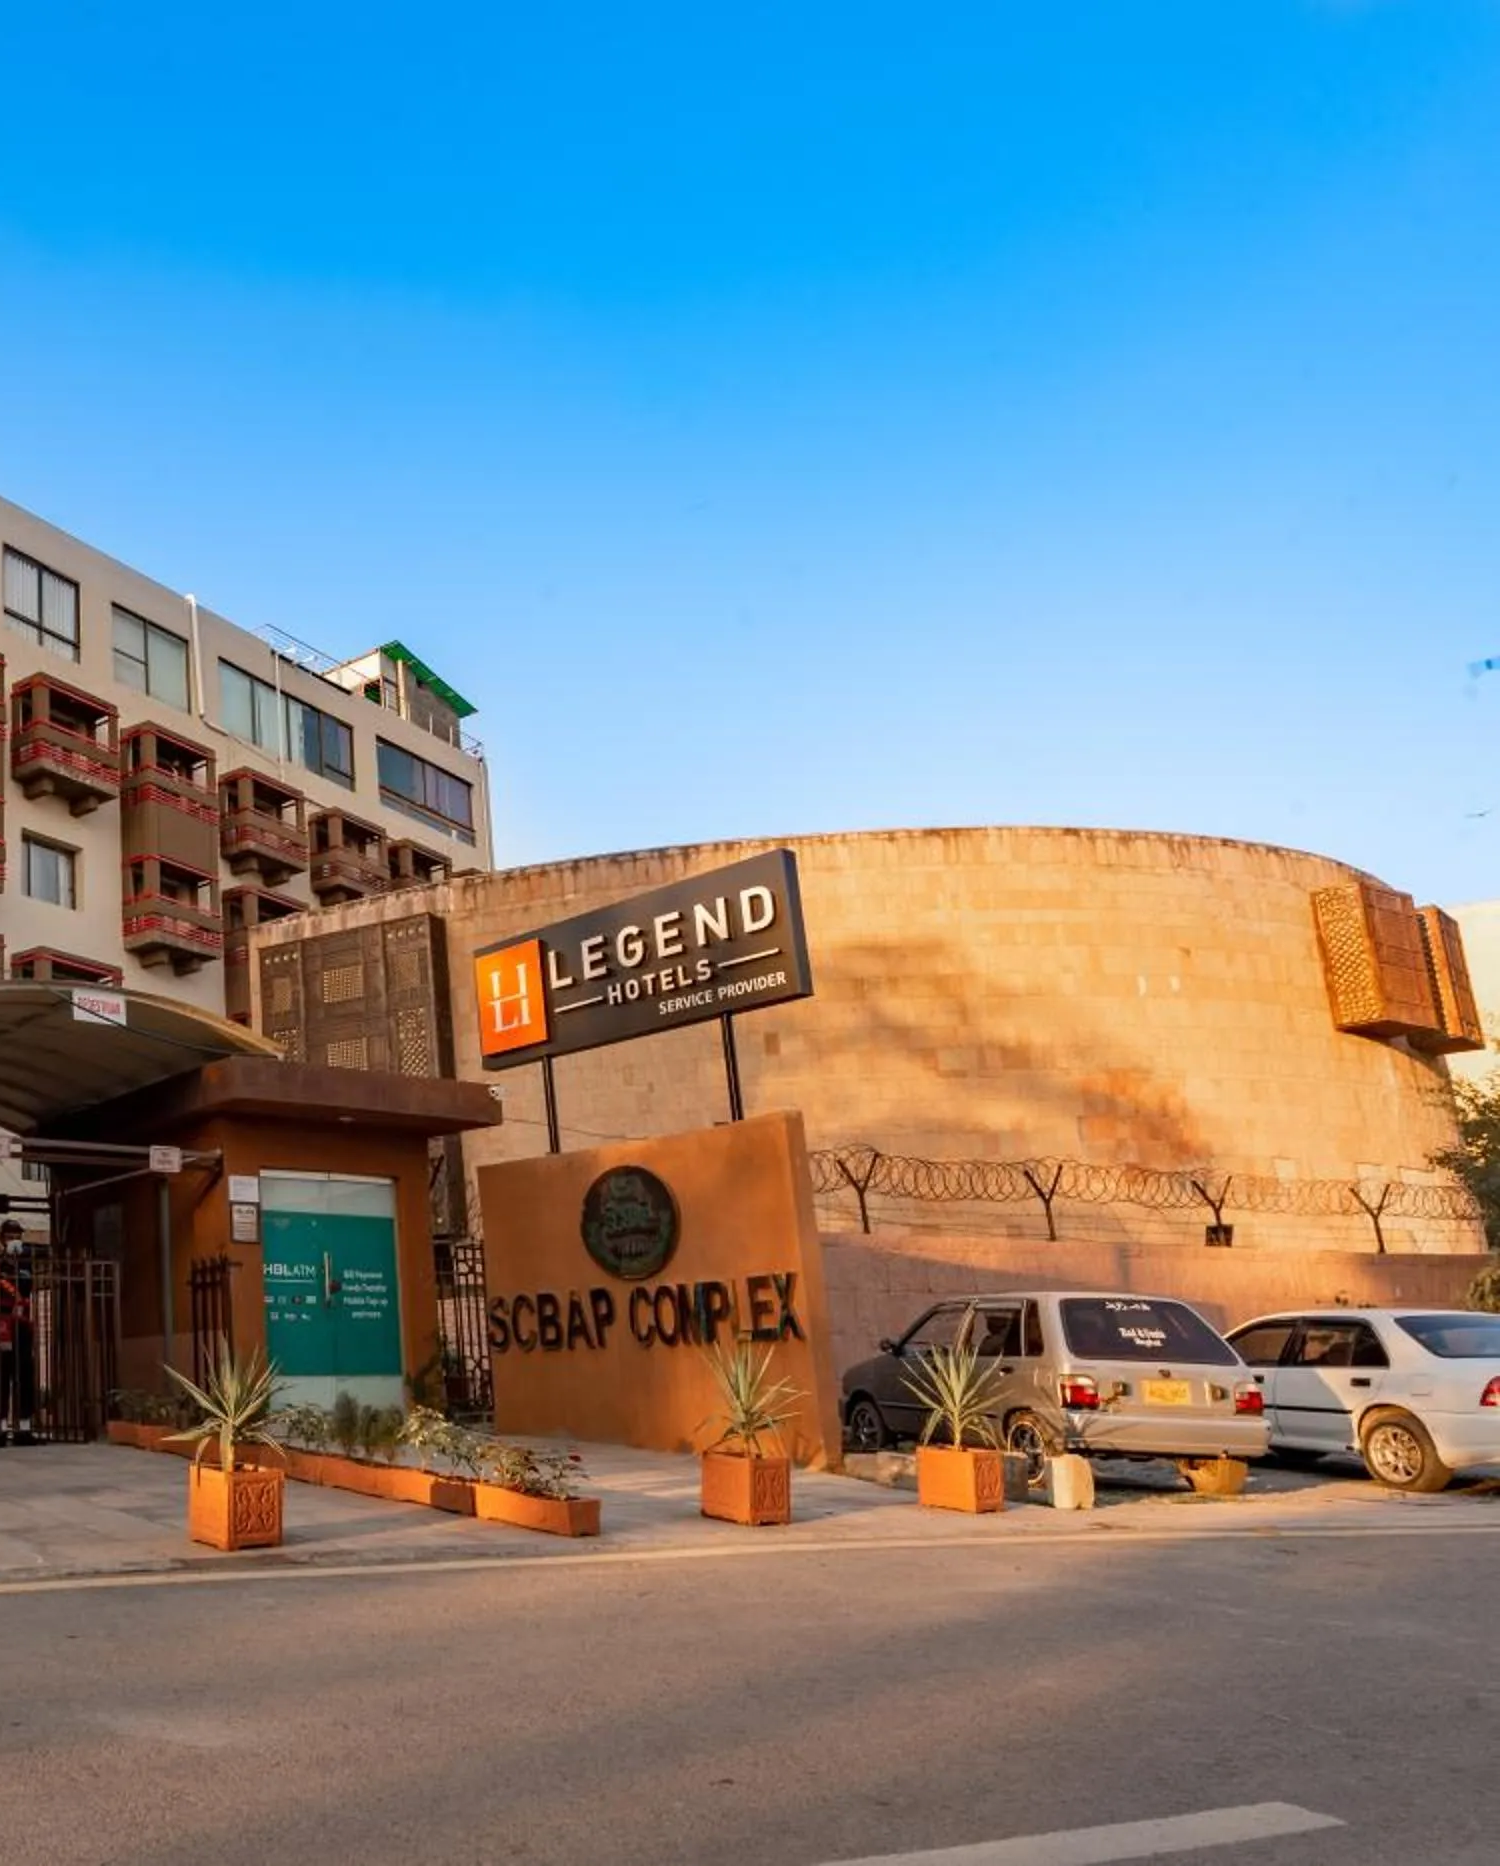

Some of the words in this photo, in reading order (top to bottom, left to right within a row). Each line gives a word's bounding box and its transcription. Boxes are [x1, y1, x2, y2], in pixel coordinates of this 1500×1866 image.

[548, 884, 778, 989] LEGEND
[607, 958, 713, 1006] HOTELS
[658, 989, 714, 1015] SERVICE
[717, 970, 788, 1002] PROVIDER
[487, 1286, 616, 1353] SCBAP
[628, 1272, 807, 1348] COMPLEX
